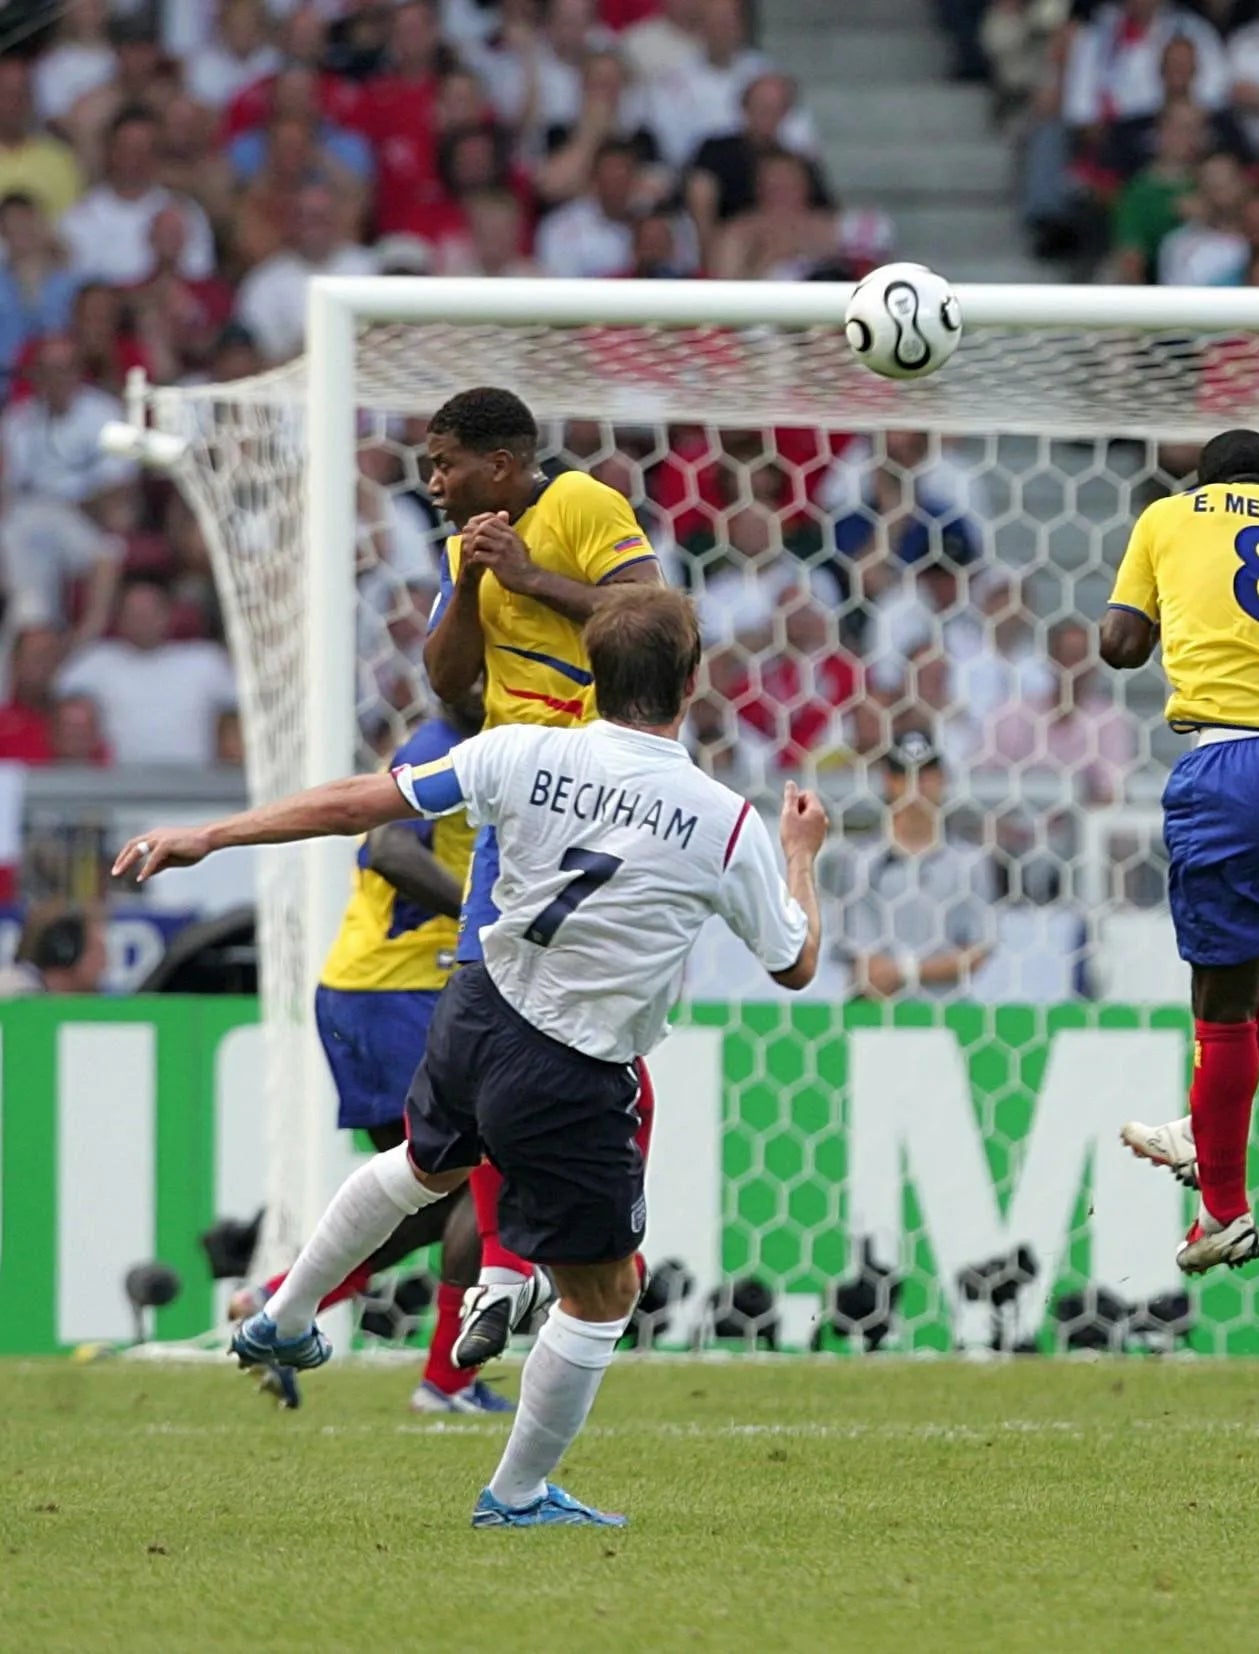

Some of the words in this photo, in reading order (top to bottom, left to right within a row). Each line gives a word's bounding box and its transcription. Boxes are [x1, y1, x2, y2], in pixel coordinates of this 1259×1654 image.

[1193, 493, 1215, 512] E.
[530, 769, 698, 849] BECKHAM
[523, 847, 625, 947] 7
